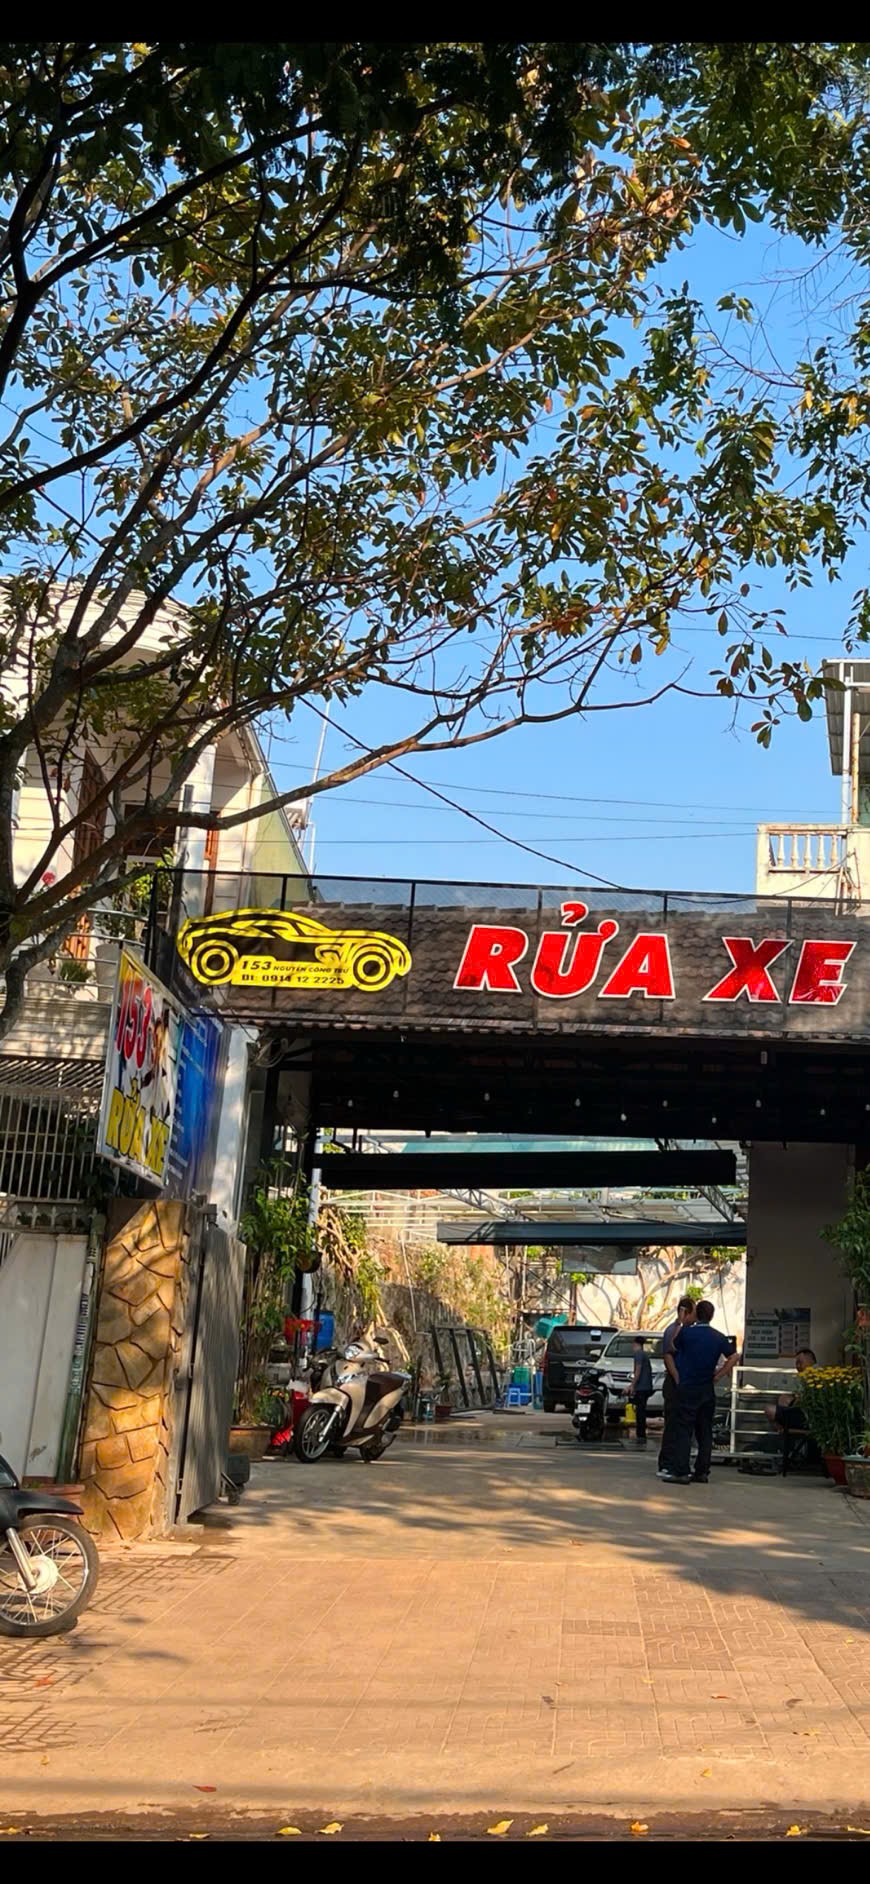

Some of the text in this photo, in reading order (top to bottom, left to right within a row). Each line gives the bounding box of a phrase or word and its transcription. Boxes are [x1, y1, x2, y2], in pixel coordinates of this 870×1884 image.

[241, 960, 272, 970] 153
[261, 974, 292, 982] 0914
[296, 975, 309, 983] 12
[313, 976, 345, 984] 2225
[452, 901, 858, 1005] RỬA XE
[116, 964, 153, 1069] 153
